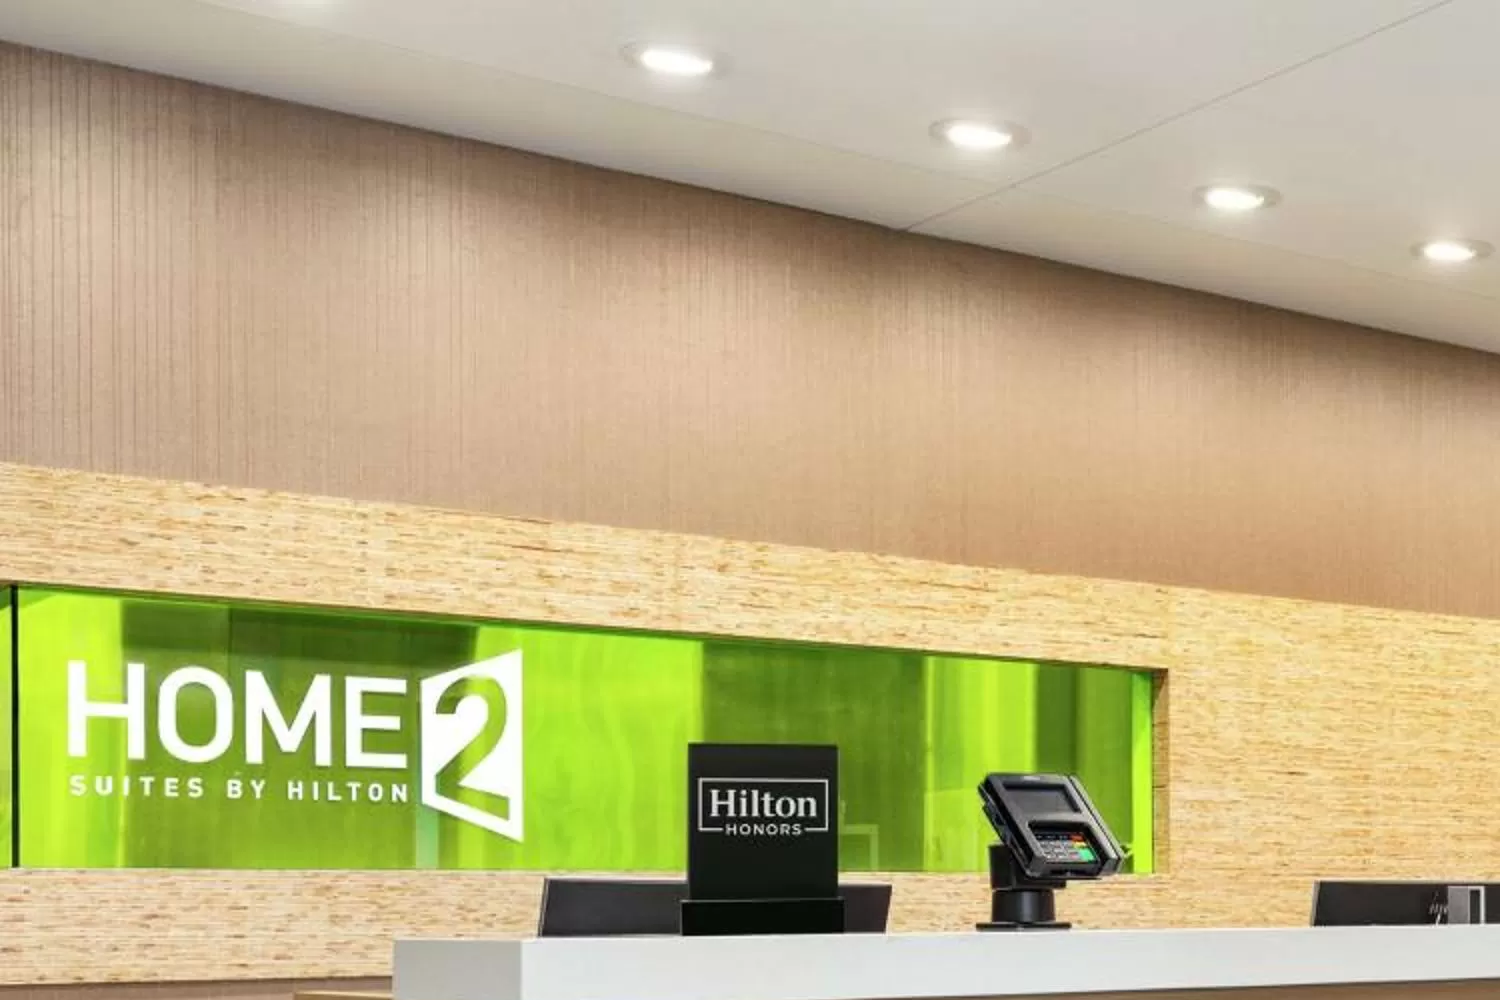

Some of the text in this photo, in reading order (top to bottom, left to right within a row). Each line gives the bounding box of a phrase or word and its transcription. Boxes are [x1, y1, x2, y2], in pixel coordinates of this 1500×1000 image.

[69, 775, 408, 803] SUITES BY HILTON
[709, 789, 818, 818] Hilton
[725, 823, 803, 836] HONORS
